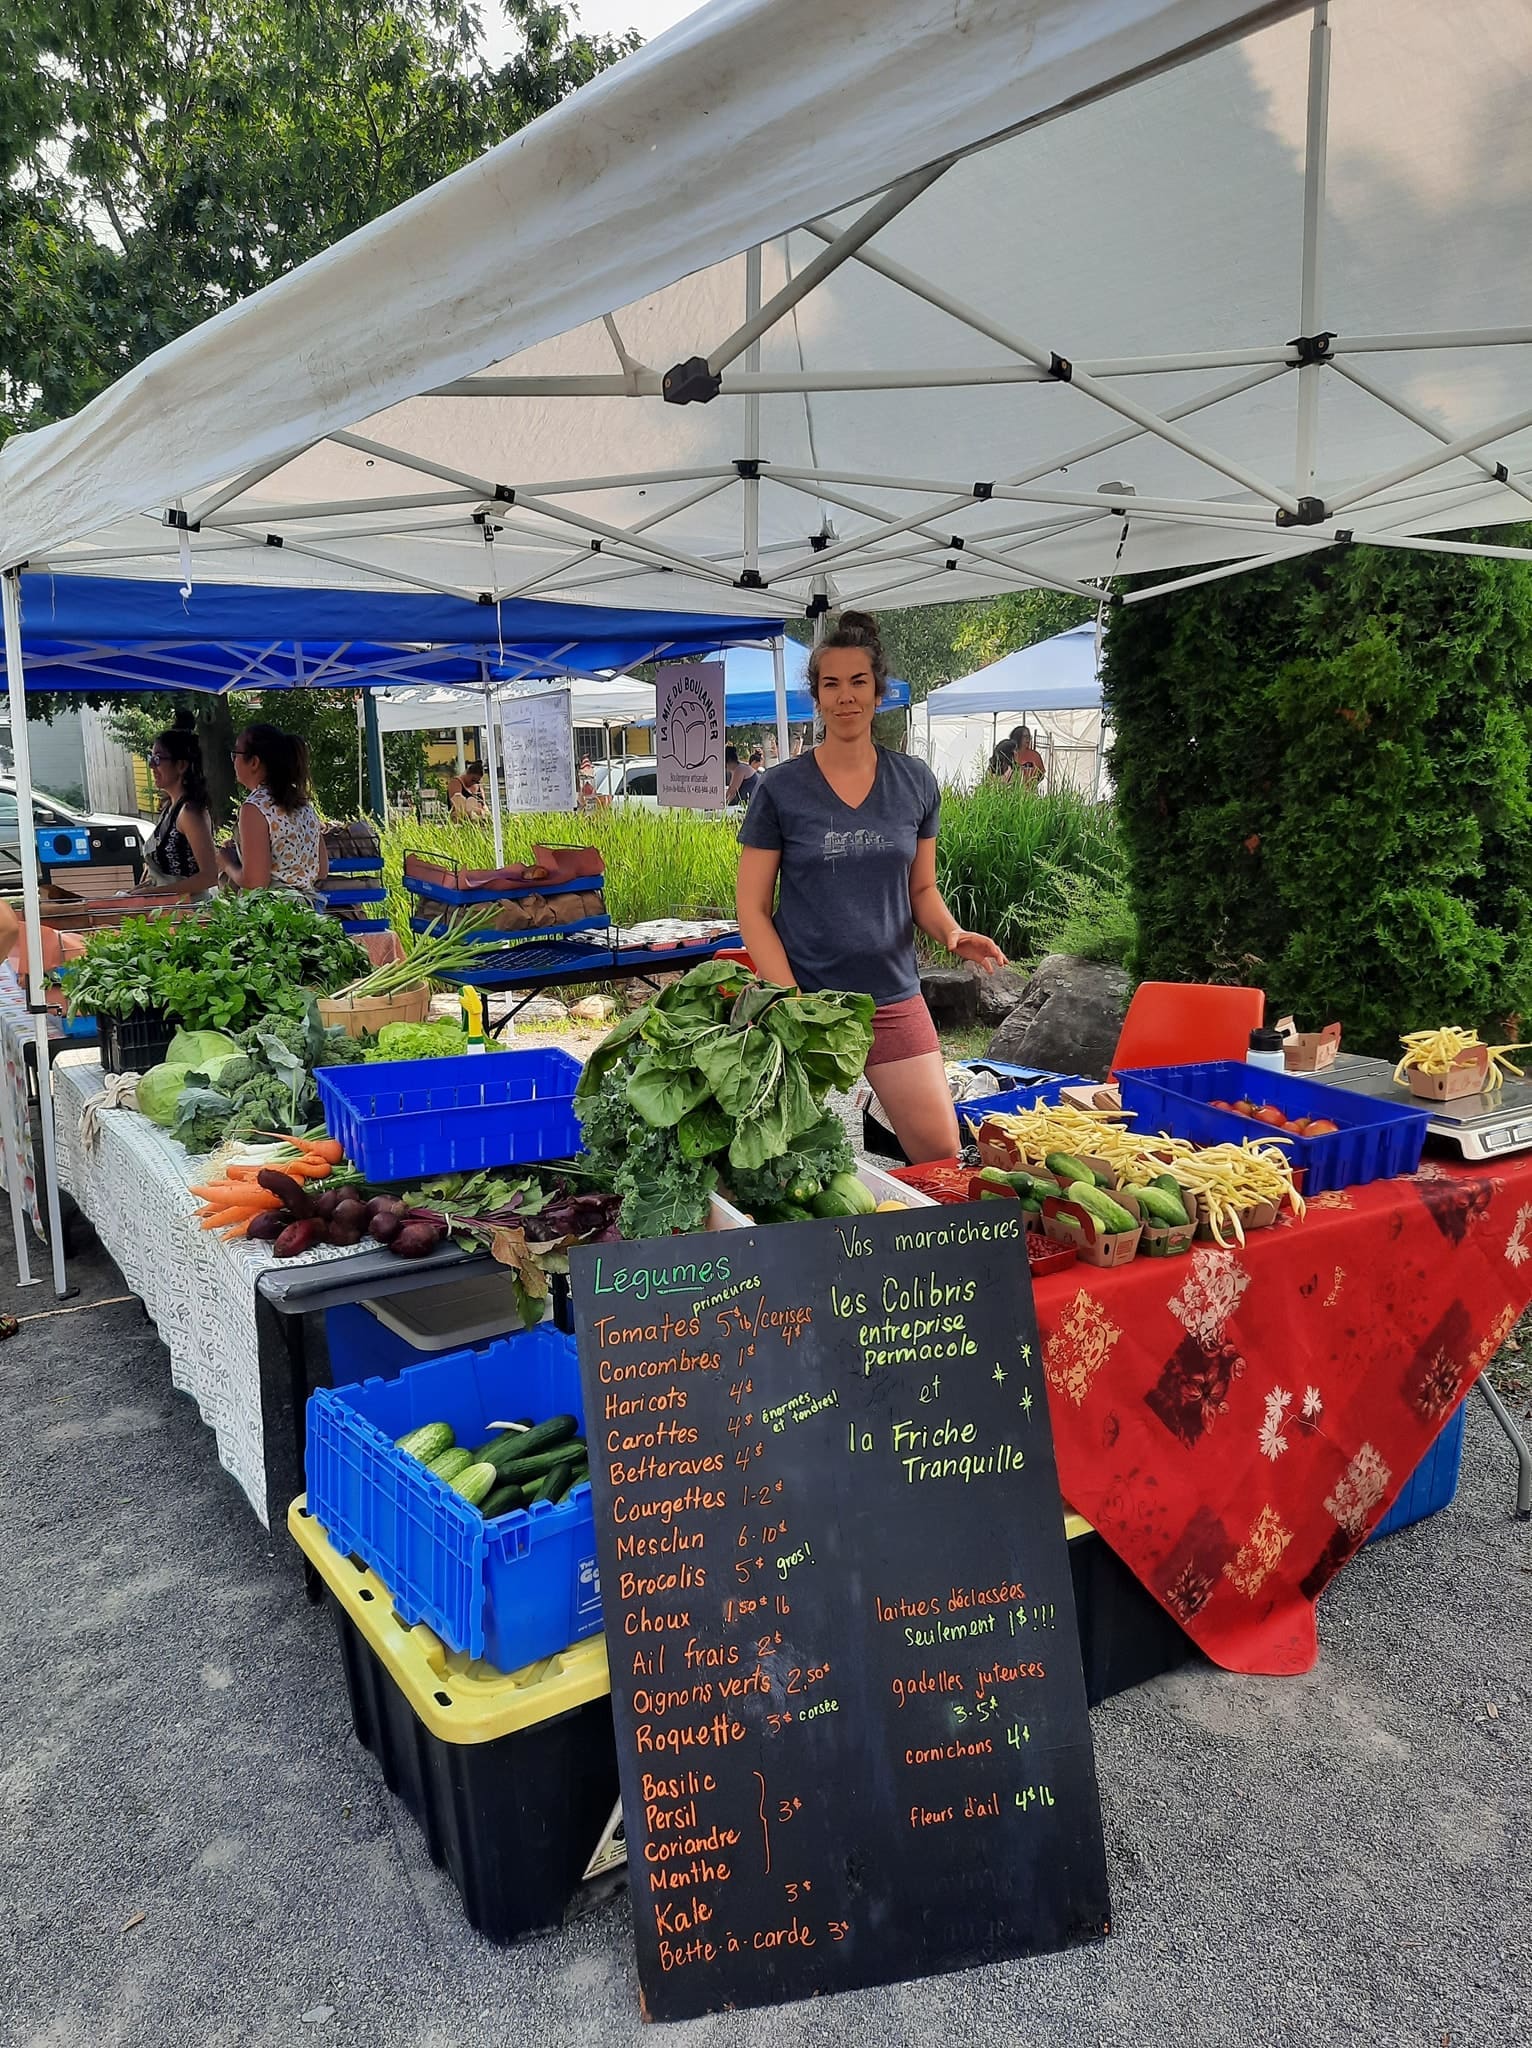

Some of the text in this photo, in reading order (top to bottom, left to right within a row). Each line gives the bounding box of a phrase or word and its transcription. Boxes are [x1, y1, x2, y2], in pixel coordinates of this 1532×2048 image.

[660, 676, 719, 742] LA MIE DU BOULANGER
[839, 1225, 873, 1258] Vos
[691, 1275, 762, 1319] primeures
[831, 1272, 977, 1318] les Colibris
[594, 1313, 700, 1349] Tomates
[859, 1313, 966, 1346] entreprise
[599, 1348, 721, 1384] Concombres
[864, 1334, 978, 1376] permacole
[604, 1386, 688, 1419] Haricots
[919, 1374, 942, 1403] et
[761, 1391, 811, 1424] énormes
[606, 1419, 698, 1452] Carottes
[772, 1418, 786, 1433] et
[892, 1419, 977, 1452] Friche
[609, 1452, 725, 1486] Betteraves
[902, 1444, 1026, 1484] Tranquille
[612, 1486, 727, 1524] Courgettes
[616, 1526, 704, 1561] Mesclun
[619, 1563, 707, 1600] Brocolis
[776, 1542, 815, 1580] gros!
[875, 1580, 1026, 1623] laitues déclassées
[623, 1607, 691, 1636] Choux
[632, 1644, 666, 1676] Ail
[684, 1637, 740, 1669] frais
[633, 1682, 714, 1715] Oignons
[718, 1662, 773, 1698] verts
[891, 1661, 1047, 1709] gadelles juteuses
[635, 1712, 747, 1754] Roquette
[798, 1699, 840, 1722] corsée
[904, 1738, 994, 1765] cornichons
[641, 1770, 717, 1802] Basilic
[645, 1800, 698, 1833] Persil
[910, 1805, 955, 1828] fleurs
[643, 1825, 742, 1863] Coriandre
[649, 1858, 732, 1893] Menthe
[654, 1896, 714, 1937] Kale
